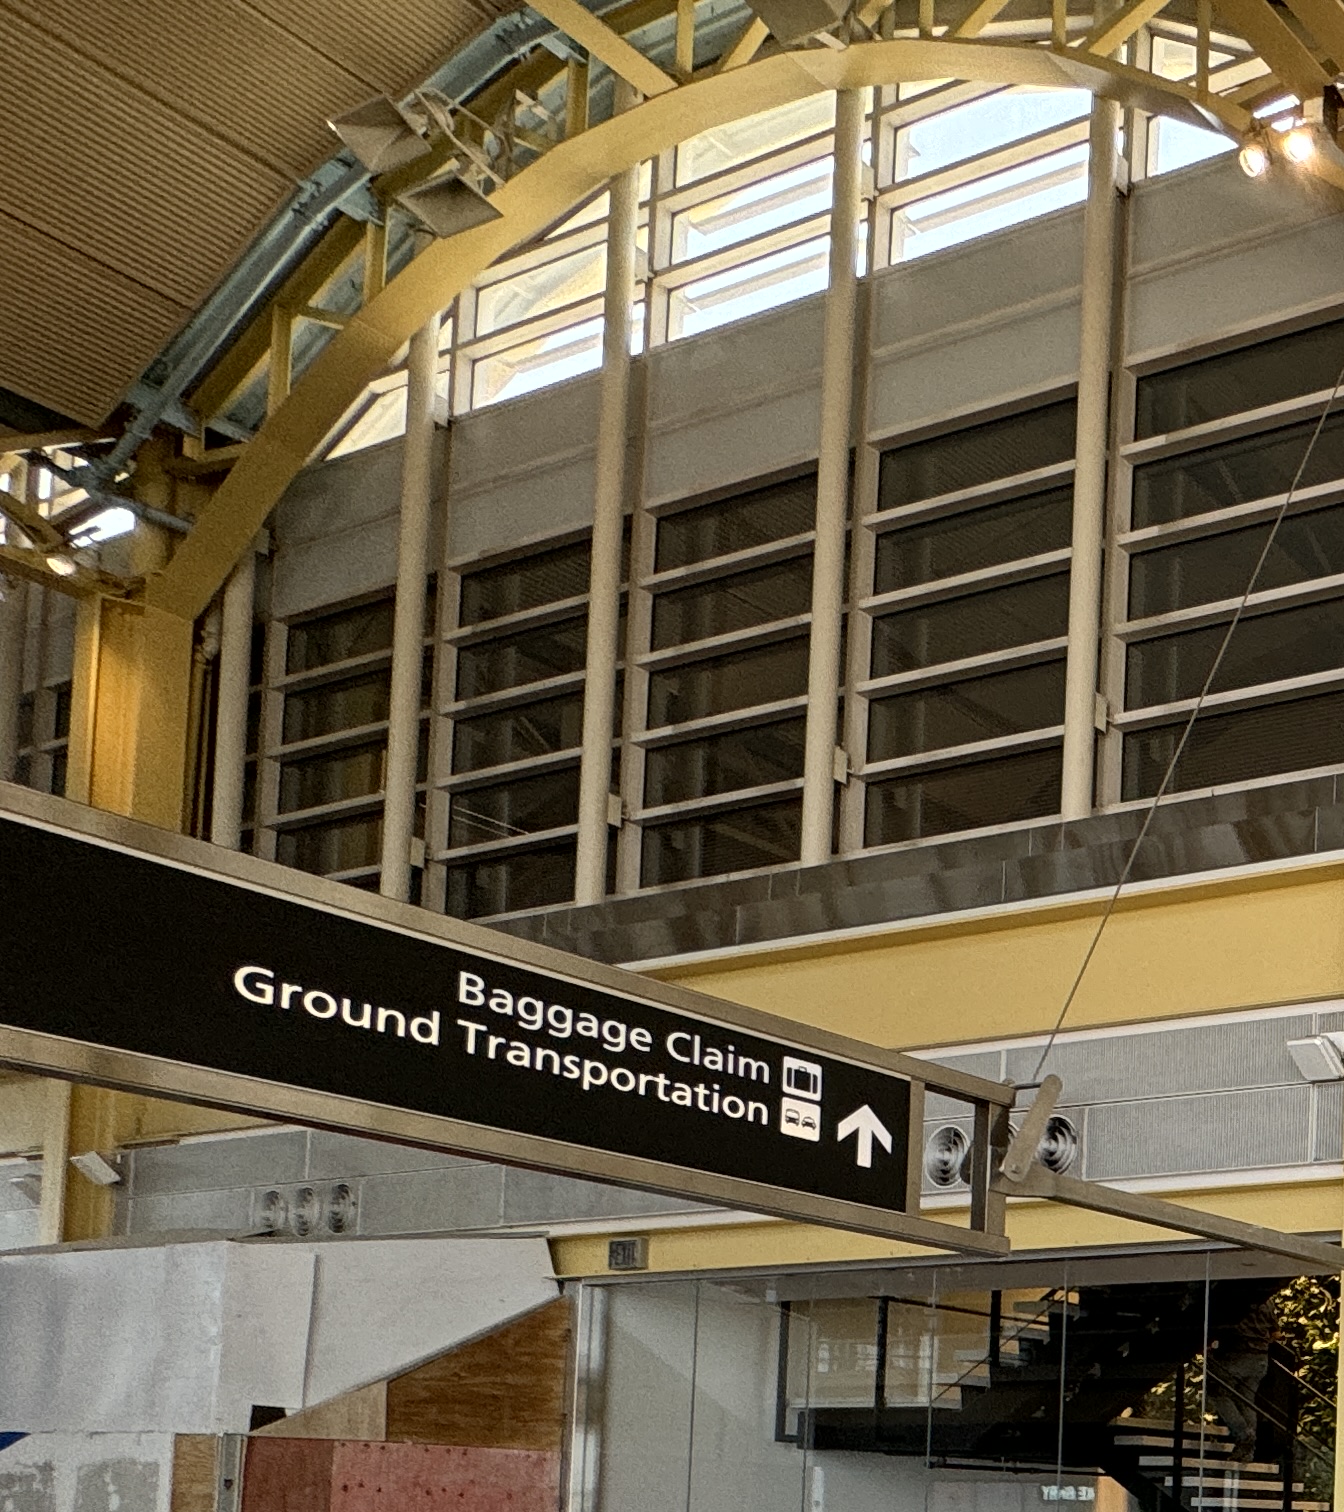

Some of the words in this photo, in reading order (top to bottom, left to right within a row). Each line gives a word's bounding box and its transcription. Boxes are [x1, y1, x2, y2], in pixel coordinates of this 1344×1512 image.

[233, 964, 441, 1047] Ground
[456, 1018, 770, 1126] Transportation
[457, 970, 653, 1053] Baggage
[665, 1031, 771, 1085] Claim
